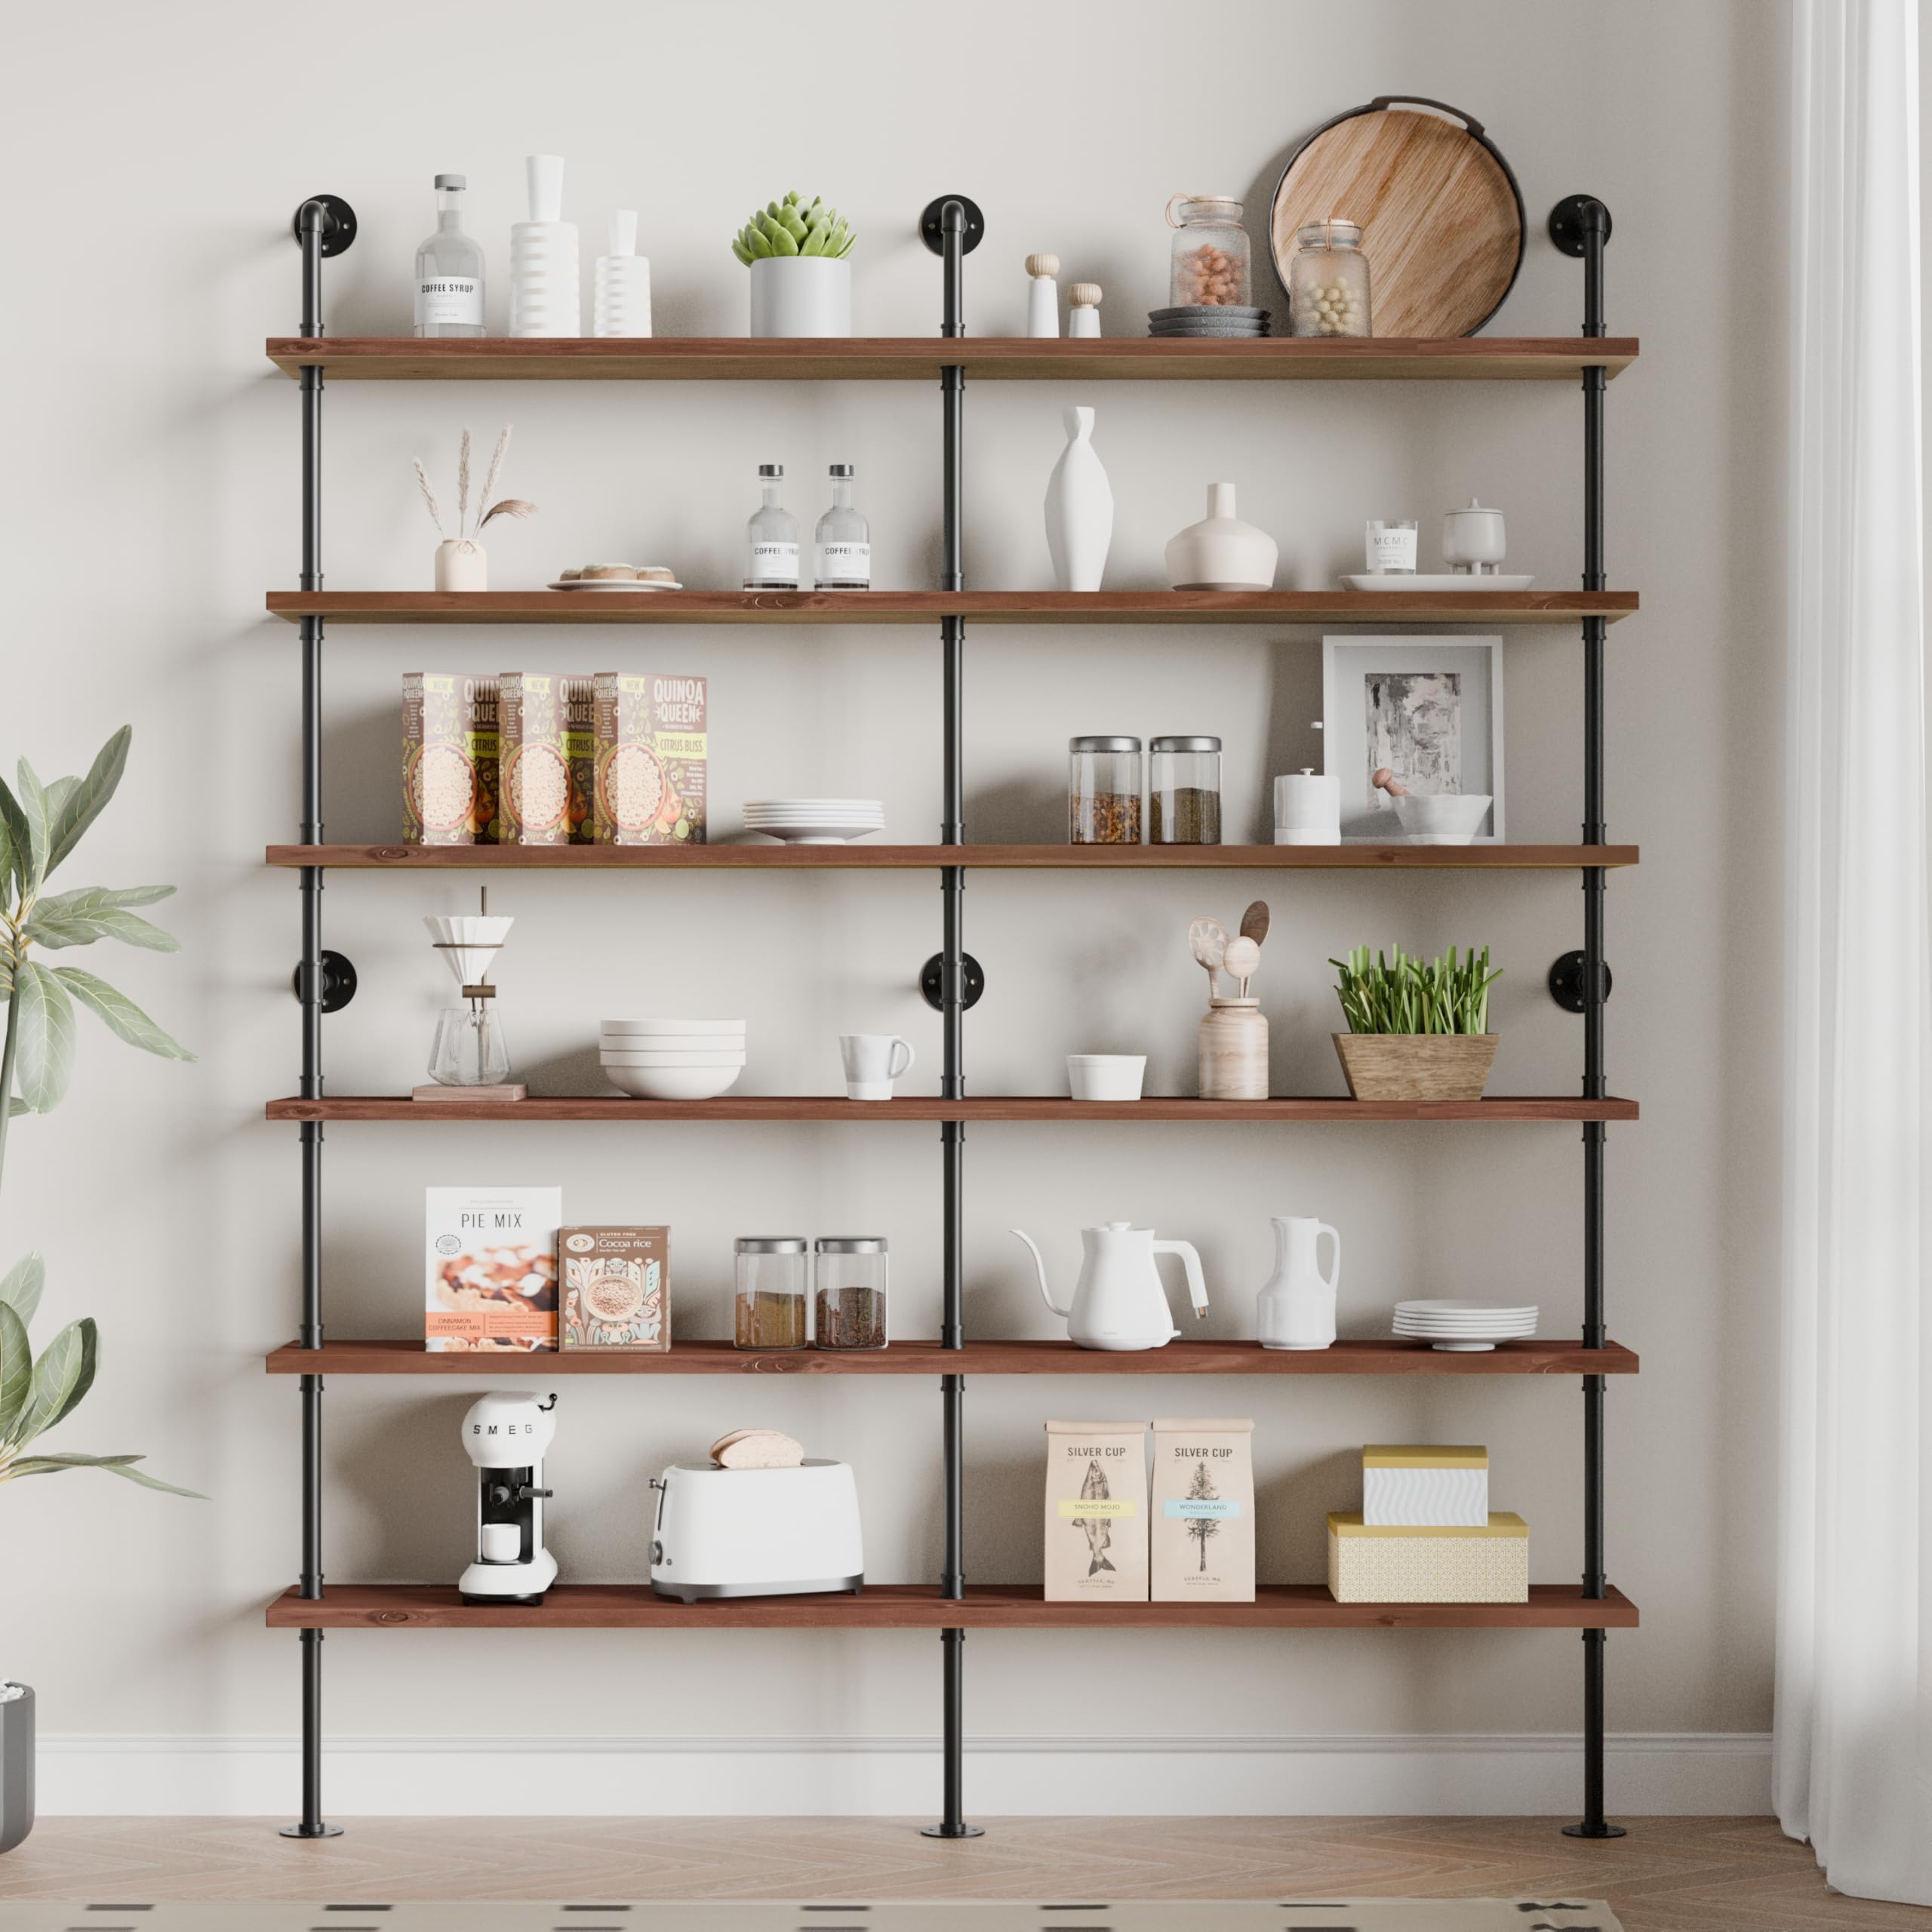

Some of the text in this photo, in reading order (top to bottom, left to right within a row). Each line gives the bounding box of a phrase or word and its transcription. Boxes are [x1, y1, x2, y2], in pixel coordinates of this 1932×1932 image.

[421, 284, 474, 293] COFFEE SYRUP
[464, 678, 500, 703] QUIN
[559, 678, 594, 703] QUIN
[654, 679, 704, 705] QUINOA
[471, 703, 500, 722] QUE
[566, 703, 594, 722] QUEE
[660, 703, 697, 723] QUEEN
[471, 739, 497, 752] CITRUS
[566, 739, 589, 752] CITRUS
[660, 739, 703, 752] CITRUS BLISS
[462, 1214, 521, 1228] PIE MIX
[598, 1238, 630, 1248] Cocoa
[633, 1238, 652, 1248] rice
[473, 1424, 532, 1435] SMEG
[1068, 1447, 1126, 1457] SILVER CUP
[1175, 1447, 1232, 1457] SILVER CUP
